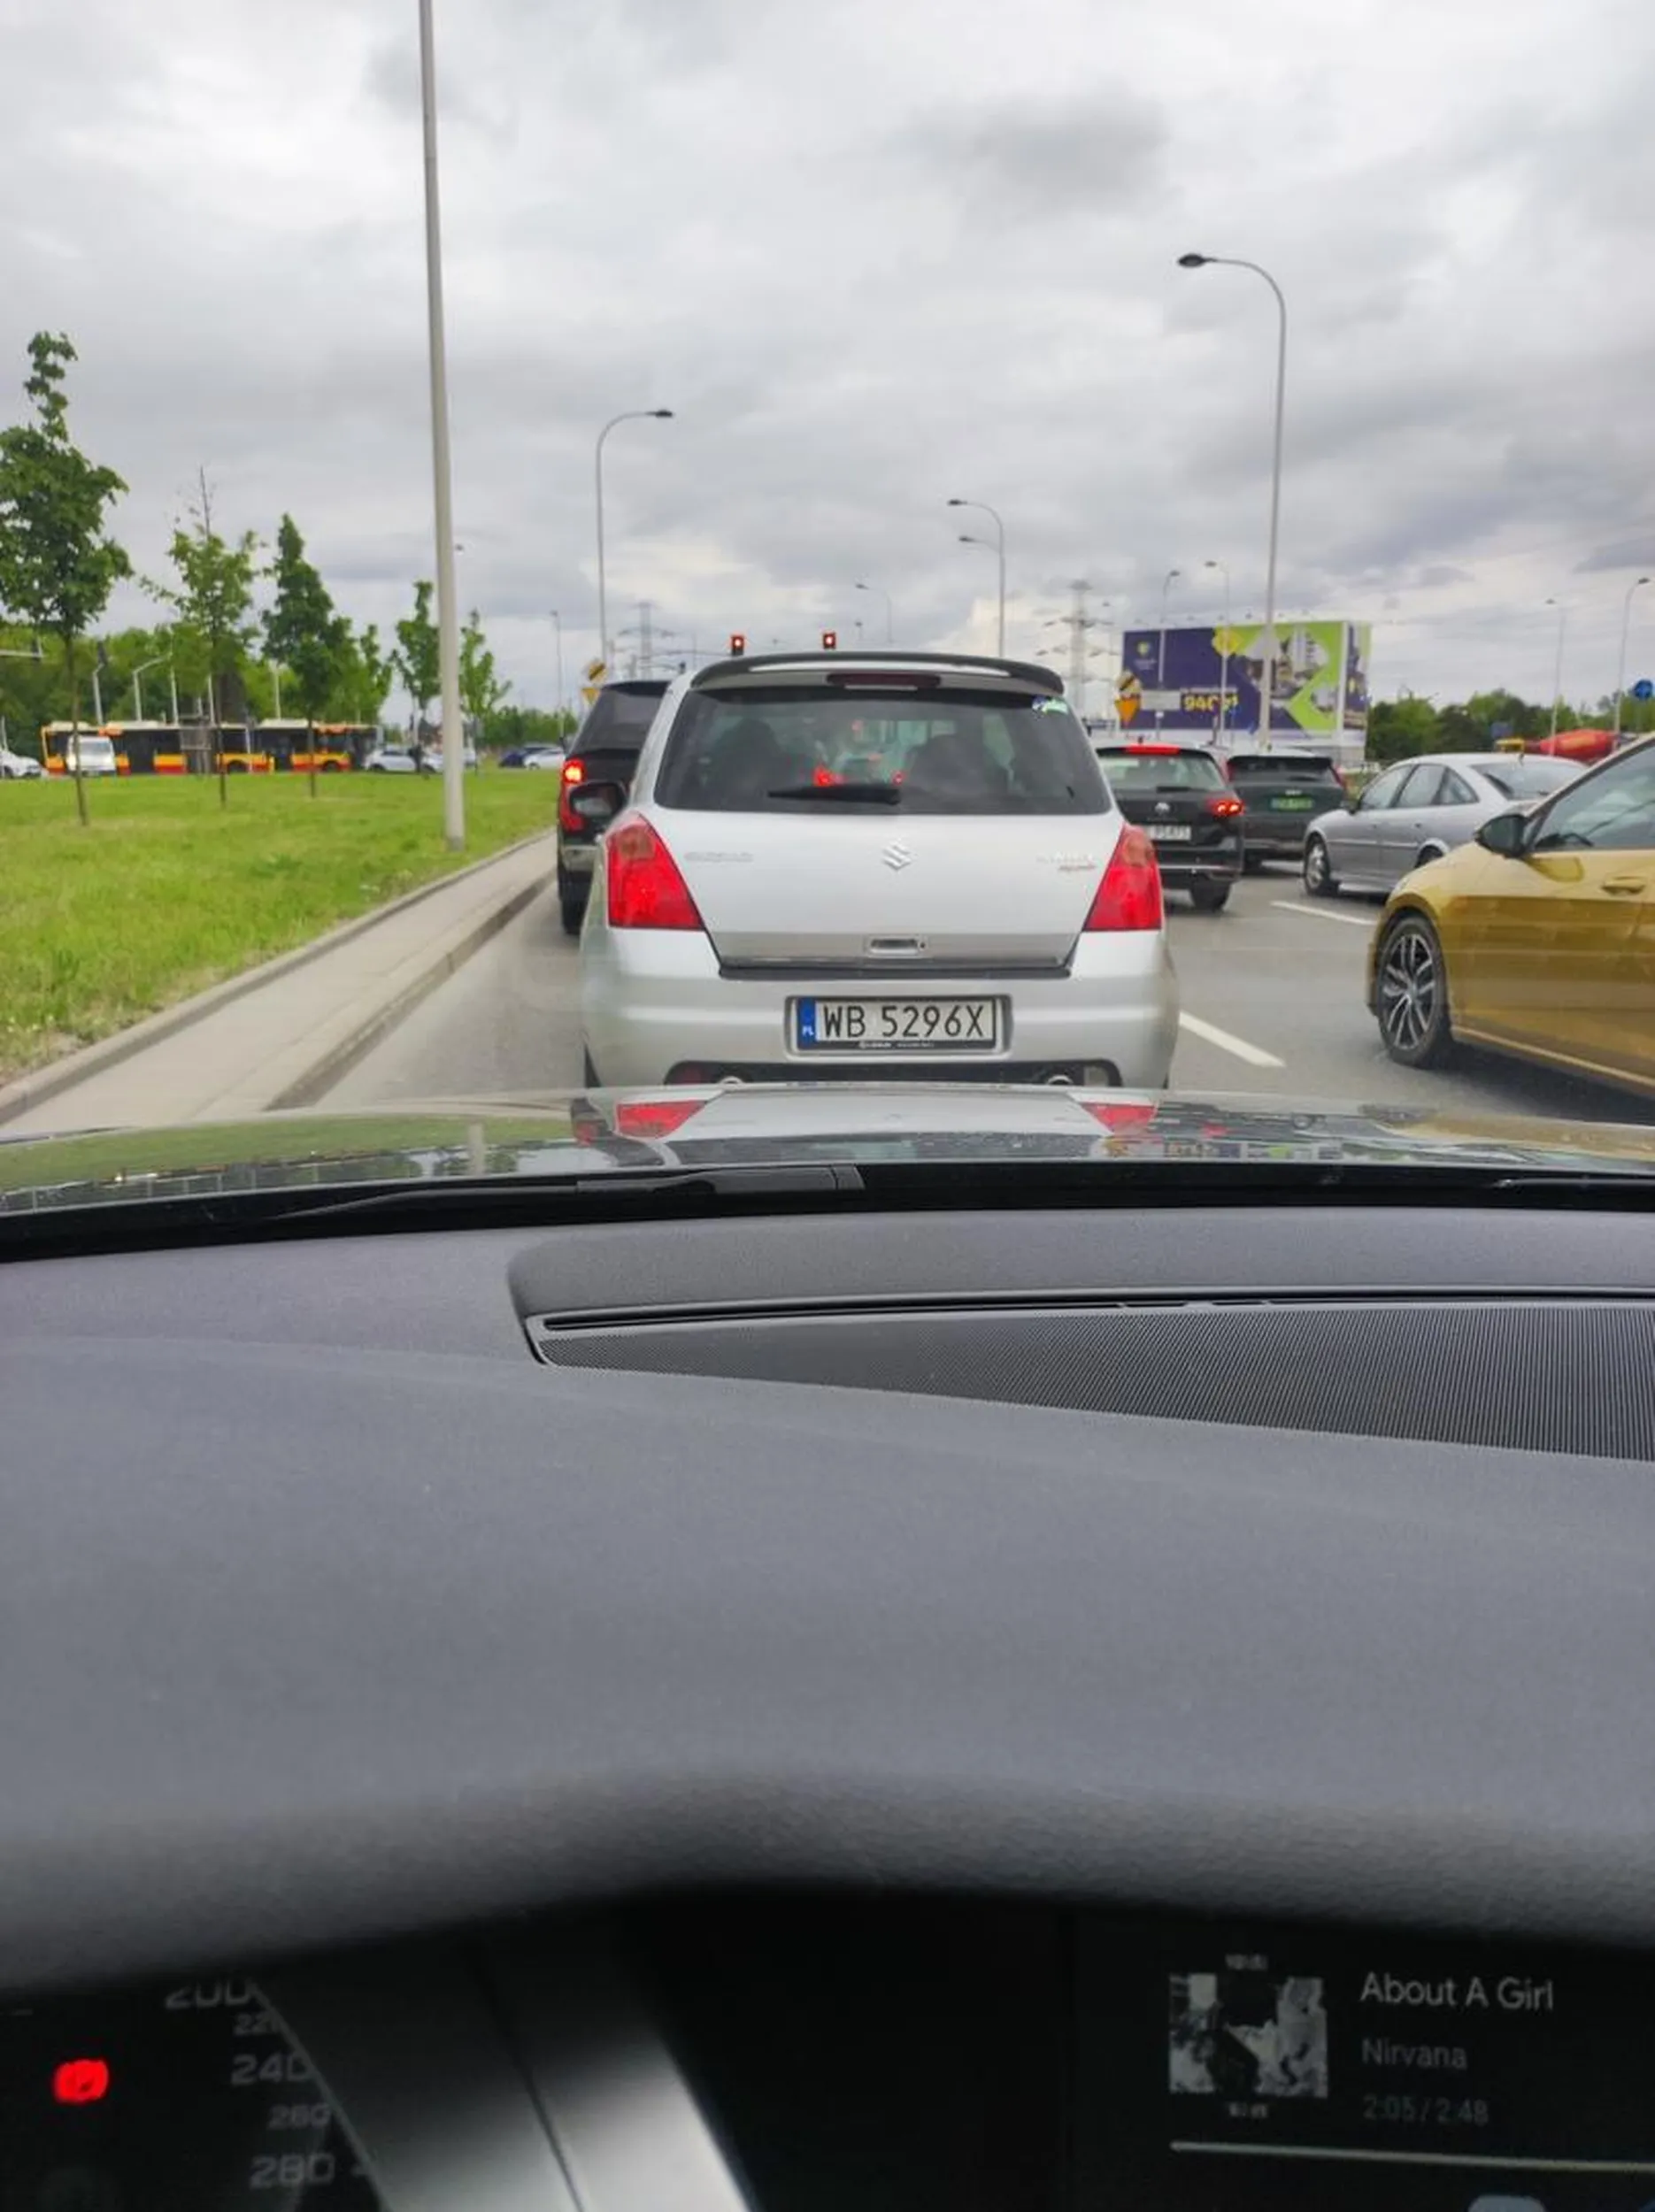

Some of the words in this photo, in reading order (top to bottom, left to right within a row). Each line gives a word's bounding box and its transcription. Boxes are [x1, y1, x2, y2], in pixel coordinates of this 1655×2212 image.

[823, 1005, 866, 1039] WB
[881, 1004, 984, 1038] 5296X
[1359, 1970, 1459, 2008] About
[1465, 1975, 1491, 2008] A
[1497, 1976, 1555, 2012] Girl
[229, 2050, 314, 2087] 240
[1360, 2035, 1469, 2071] Nirvana
[249, 2151, 336, 2191] 280
